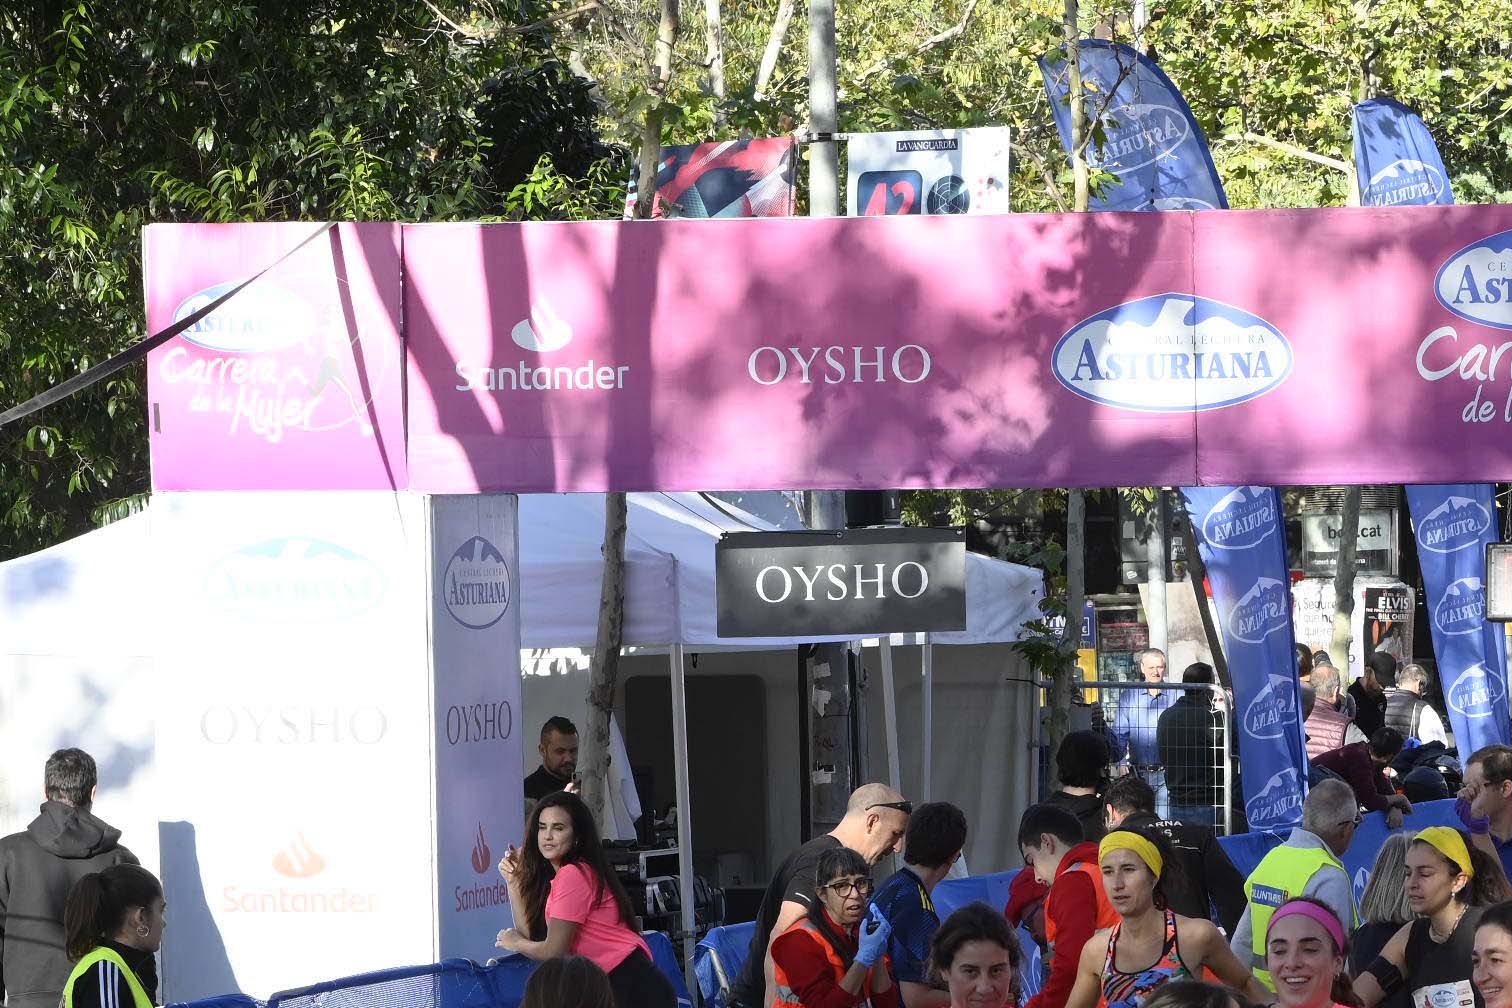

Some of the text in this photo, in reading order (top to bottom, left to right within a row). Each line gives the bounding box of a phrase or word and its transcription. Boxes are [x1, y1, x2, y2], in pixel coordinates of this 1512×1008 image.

[897, 139, 957, 151] LA VANGUARDIA
[455, 358, 630, 392] Santander
[747, 343, 933, 385] OYSHO
[1071, 338, 1275, 381] ASTURIANA
[1462, 384, 1497, 424] de
[449, 569, 507, 606] ASTURIANA
[755, 561, 930, 603] OYSHO
[1377, 596, 1409, 609] ELVIS
[445, 700, 513, 746] OYSHO
[223, 884, 379, 913] Santander
[454, 878, 509, 913] Santande
